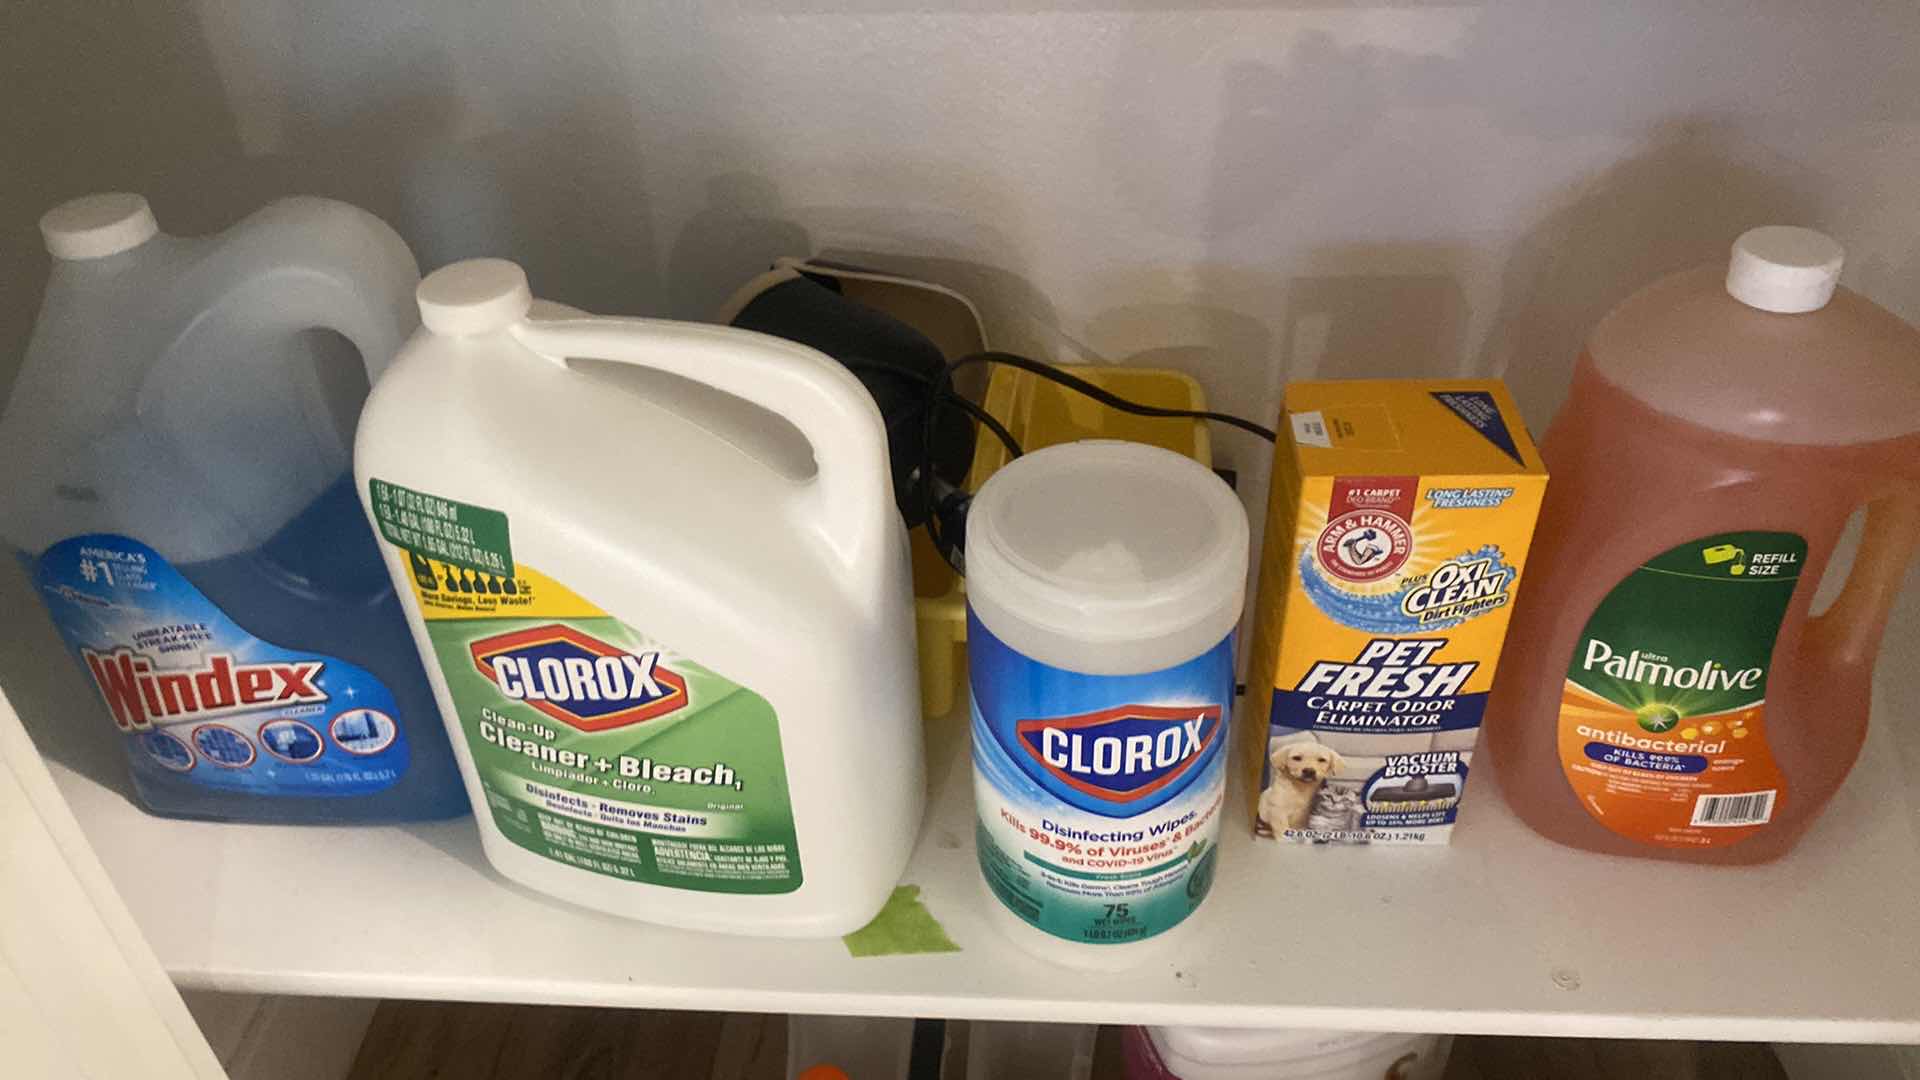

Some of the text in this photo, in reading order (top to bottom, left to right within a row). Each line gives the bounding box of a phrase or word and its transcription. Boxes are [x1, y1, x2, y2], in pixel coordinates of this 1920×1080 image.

[1363, 488, 1401, 497] CARPET
[1426, 487, 1514, 500] LONG LASTING
[1432, 499, 1505, 509] FRESHNESS
[1323, 515, 1408, 555] ARM & HAMMER
[1748, 564, 1781, 576] SIZE
[1751, 552, 1797, 564] REFILL
[80, 558, 114, 587] #1
[1401, 560, 1489, 590] PLUS OXI
[1405, 574, 1505, 614] CLEAN
[1423, 594, 1507, 623] Dirt Fighters
[1357, 639, 1448, 666] PET
[1583, 638, 1763, 691] Palmolive
[491, 651, 663, 702] CLOROX
[1298, 661, 1479, 699] FRESH
[84, 653, 326, 728] Windex
[1306, 696, 1457, 713] CARPET ODOR
[482, 706, 557, 742] Clean-Up
[1315, 711, 1442, 727] ELIMINATOR
[479, 721, 590, 771] Cleaner
[1041, 712, 1206, 777] CLOROX
[1575, 722, 1726, 755] antibacterial
[1387, 752, 1459, 768] VACUUM
[1603, 753, 1621, 764] OF
[1613, 748, 1645, 761] KILLS
[531, 761, 600, 786] Limpiador
[1385, 762, 1459, 778] BOOSTER
[525, 783, 708, 827] Disinfects Removes Stains
[707, 801, 744, 812] Original
[600, 814, 624, 825] Quita
[643, 819, 687, 833] Manchas
[1001, 807, 1027, 834] Kills
[1029, 828, 1083, 857] 99.9%
[1088, 845, 1105, 857] of
[1172, 831, 1183, 844] &
[1041, 818, 1144, 844] Disinfecting
[1061, 854, 1085, 867] and
[1086, 856, 1146, 869] COVID-19
[1103, 903, 1129, 919] 75
